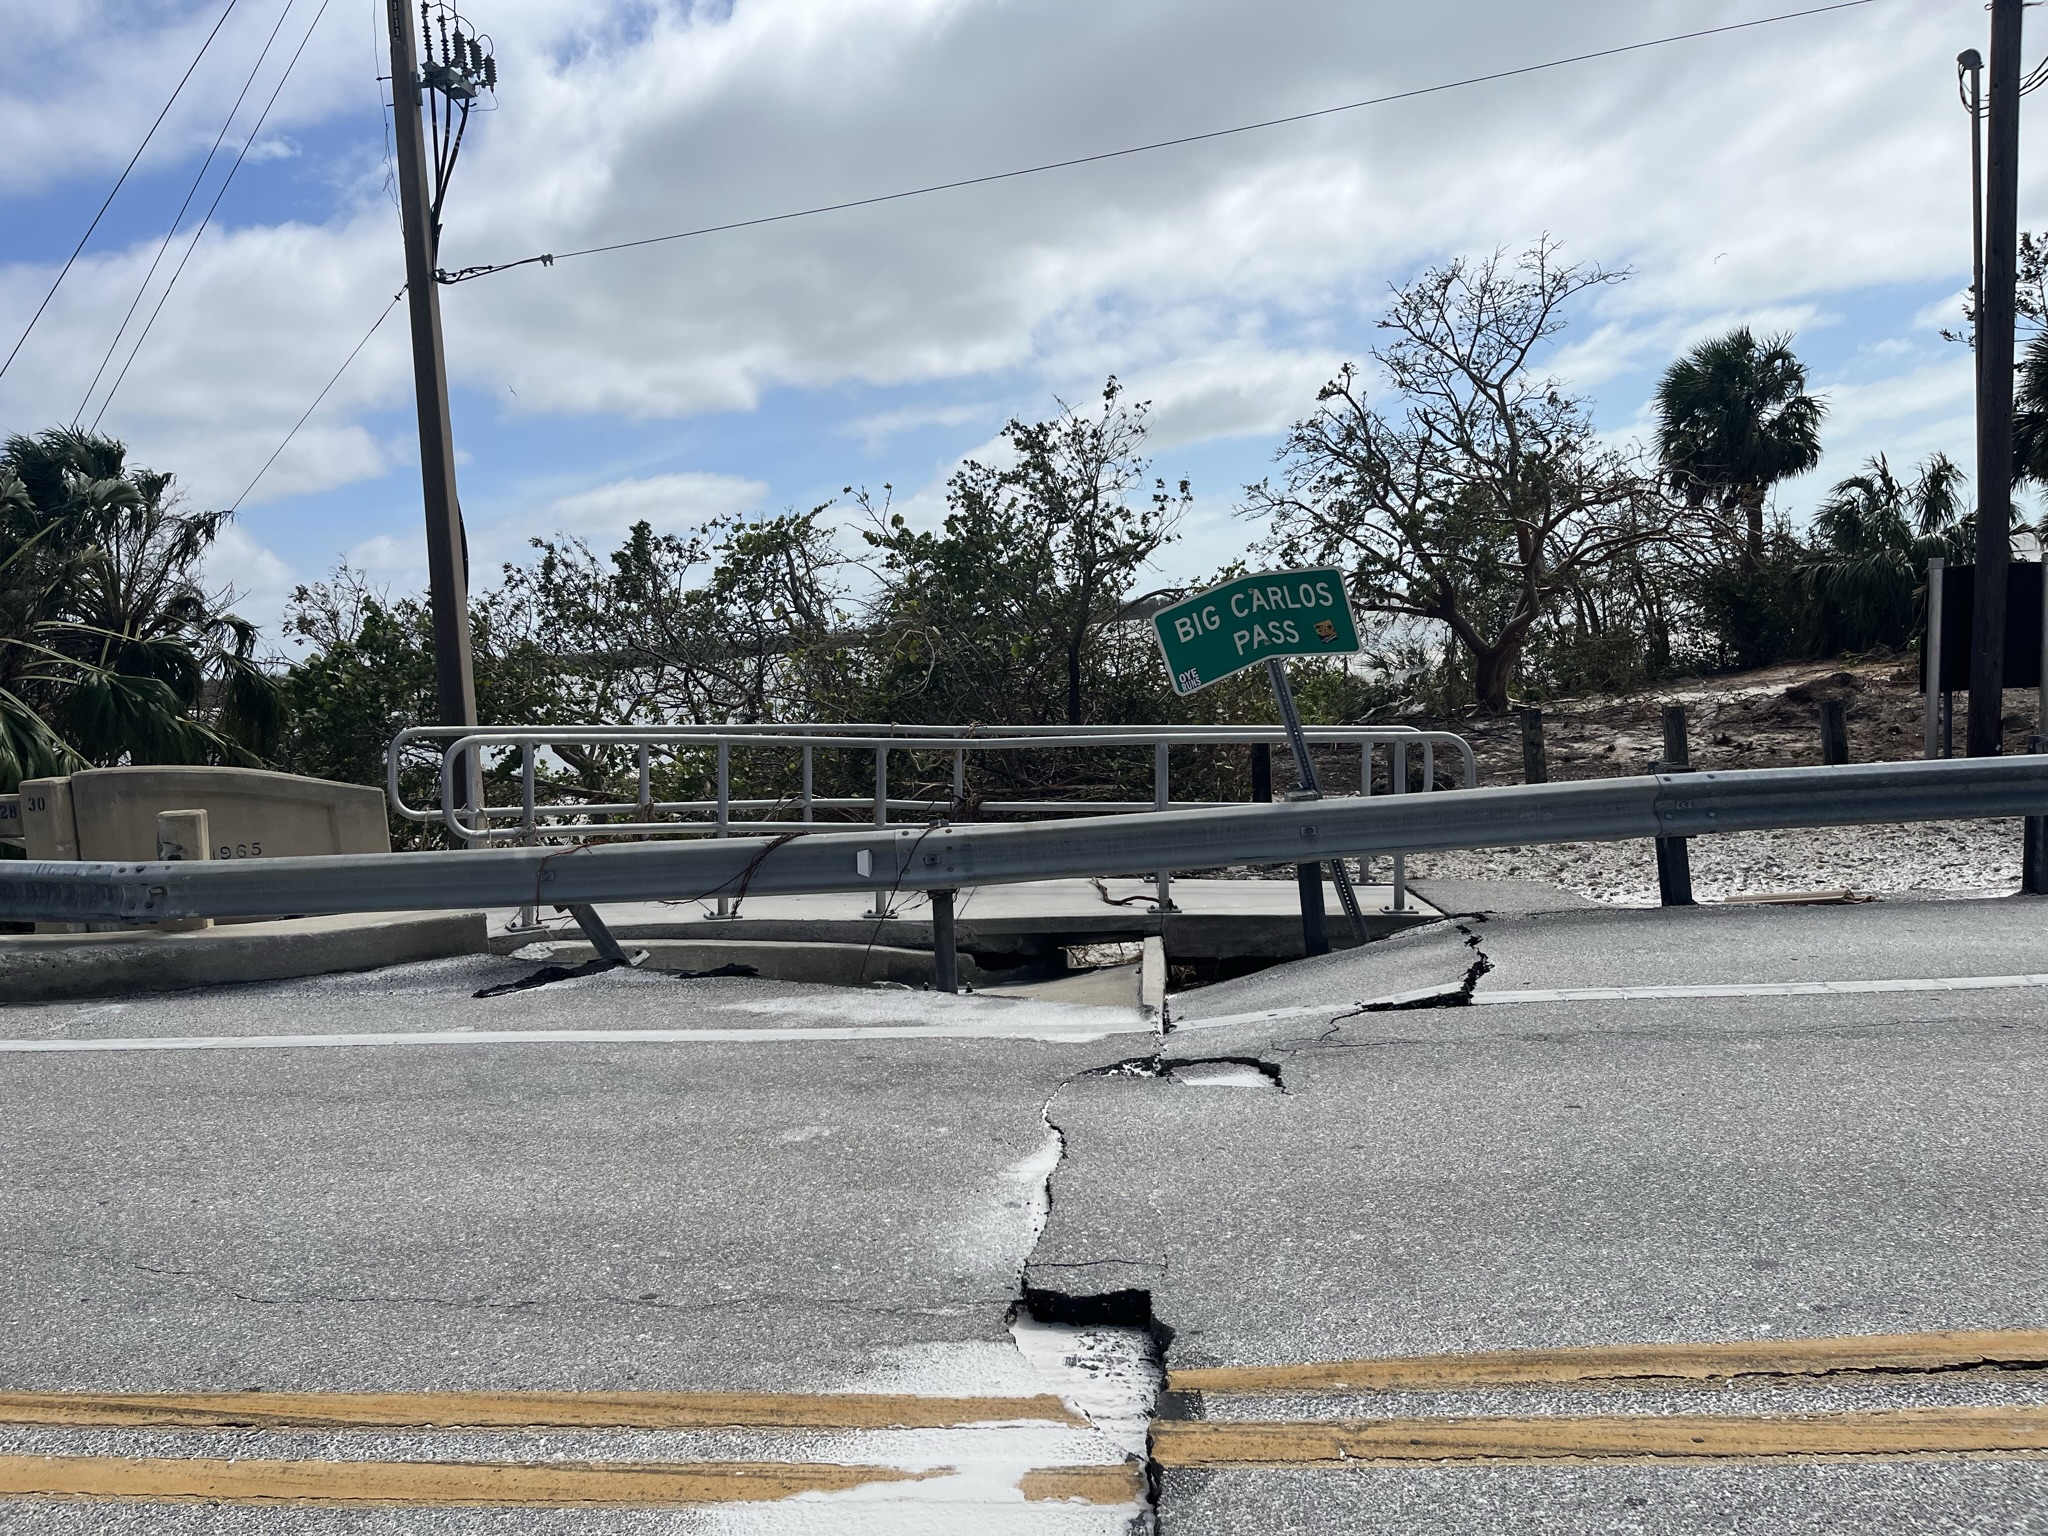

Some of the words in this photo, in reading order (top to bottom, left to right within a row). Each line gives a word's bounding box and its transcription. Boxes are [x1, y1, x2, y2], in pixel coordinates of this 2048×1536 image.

[1174, 605, 1221, 643] BIG
[1230, 582, 1333, 618] CARLOS
[1233, 619, 1300, 656] PASS
[1178, 667, 1199, 683] OYE
[1181, 676, 1202, 692] RUNS
[28, 797, 45, 811] 30
